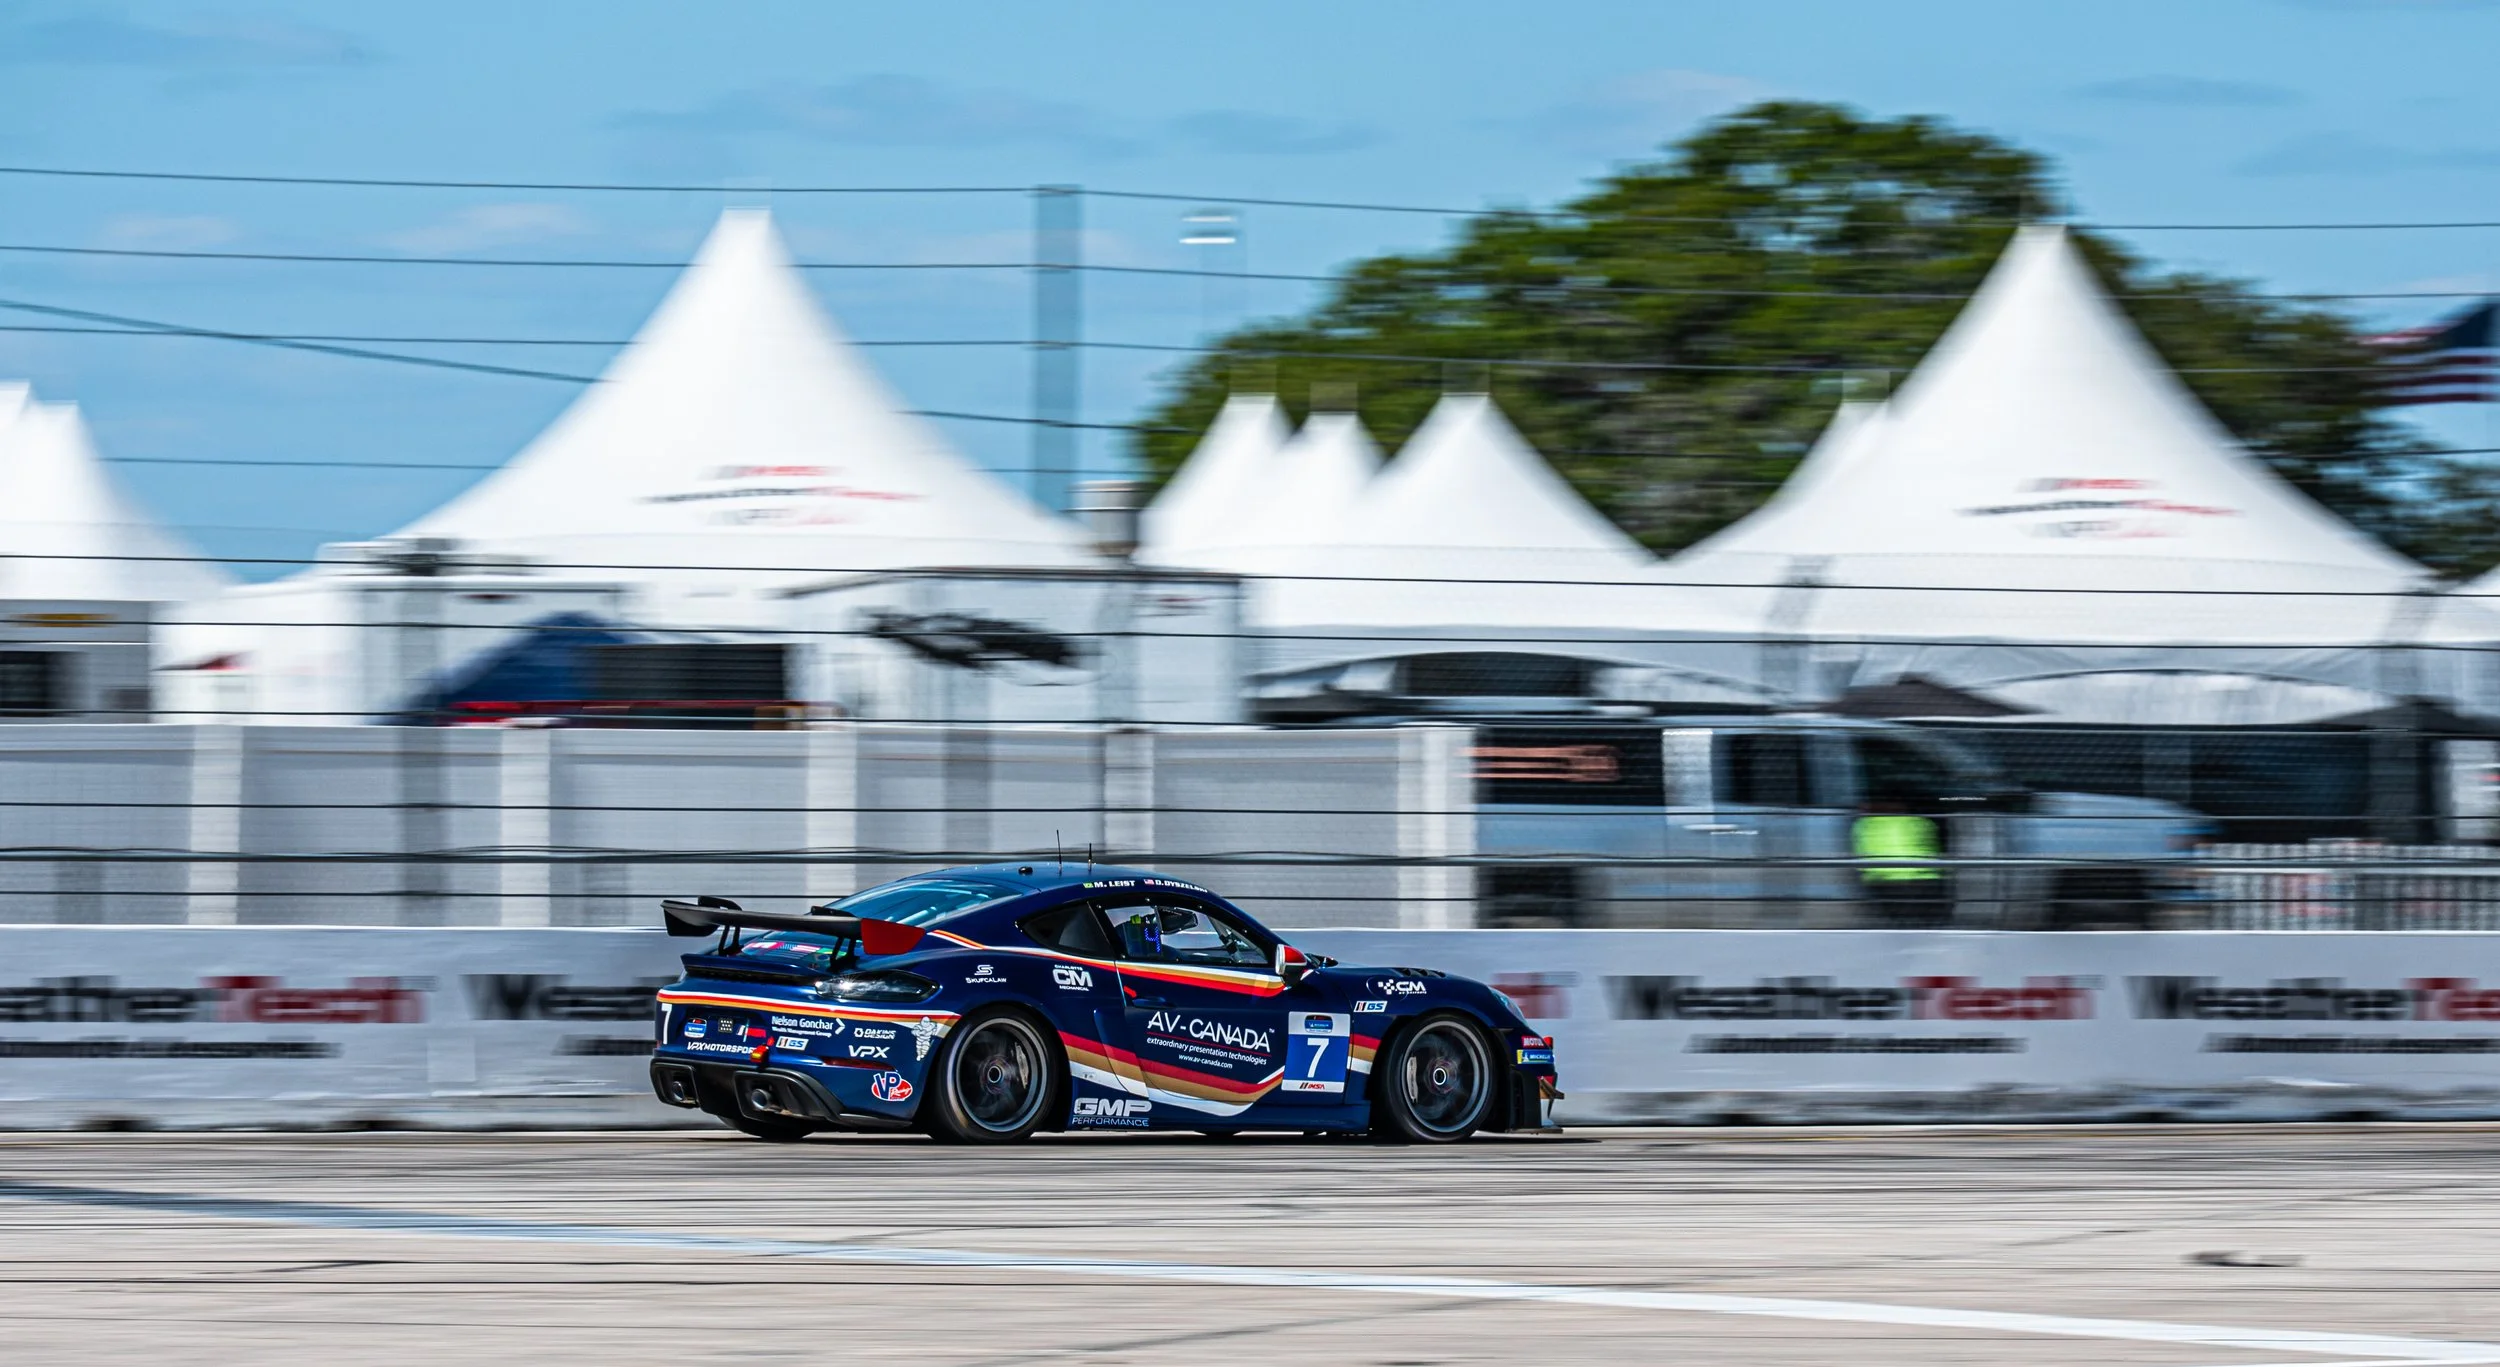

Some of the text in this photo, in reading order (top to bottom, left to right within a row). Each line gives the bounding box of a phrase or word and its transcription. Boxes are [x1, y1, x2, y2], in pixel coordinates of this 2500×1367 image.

[1052, 969, 1093, 987] CM
[661, 1002, 673, 1045] 7
[772, 1015, 834, 1030] Nelson Gonchar
[848, 1045, 890, 1058] VPX
[1147, 1037, 1267, 1065] extraordinary presentation technologies
[1307, 1037, 1329, 1078] 7
[1178, 1053, 1233, 1069] www.av-canada.com
[873, 1071, 902, 1101] VP
[1073, 1097, 1152, 1117] GMP
[1072, 1117, 1149, 1127] PERFORMANCE
